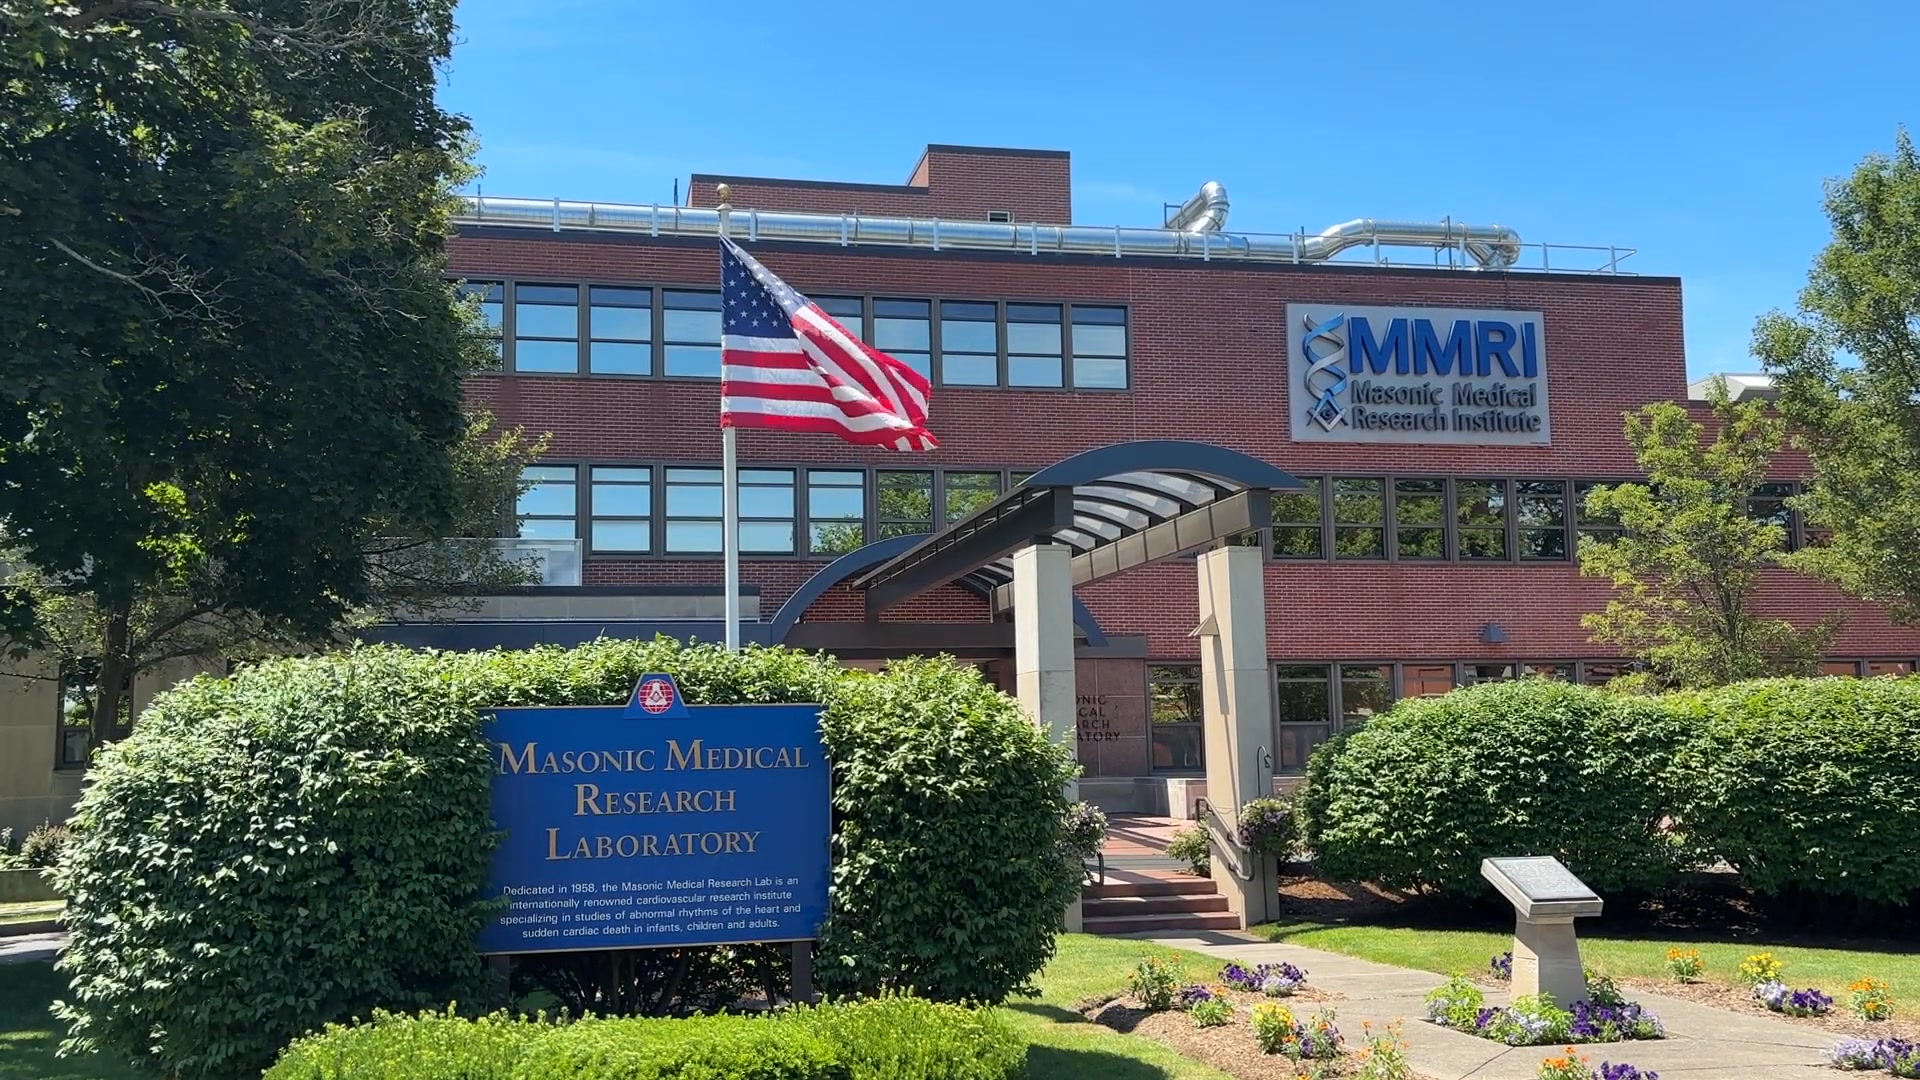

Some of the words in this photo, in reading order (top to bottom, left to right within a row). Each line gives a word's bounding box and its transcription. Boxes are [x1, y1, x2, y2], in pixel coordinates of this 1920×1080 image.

[1348, 316, 1538, 378] MMRI
[1351, 380, 1443, 406] Masonic
[1452, 382, 1537, 408] Medical
[1352, 406, 1448, 432] Research
[1452, 407, 1541, 432] Institute
[500, 742, 655, 775] MASONIC
[664, 739, 809, 772] MEDICAL
[573, 783, 736, 816] RESEARCH
[545, 828, 761, 860] LABORATORY
[503, 885, 554, 896] Dedicated
[558, 884, 567, 894] in
[571, 883, 598, 894] 1958,
[602, 882, 618, 892] the
[621, 881, 663, 892] Masonic
[666, 879, 704, 890] Medical
[708, 878, 751, 888] Research
[755, 876, 772, 887] Lab
[775, 876, 783, 886] is
[787, 877, 799, 886] an
[509, 898, 580, 910] internationally
[583, 896, 633, 907] renowned
[636, 894, 706, 906] cardiovascular
[709, 891, 750, 902] research
[753, 890, 792, 900] institute
[500, 914, 558, 926] specializing
[562, 912, 571, 923] in
[575, 911, 611, 922] studies
[615, 910, 626, 920] of
[629, 909, 675, 920] abnormal
[679, 907, 718, 919] rhythms
[722, 906, 732, 916] of
[736, 905, 751, 915] the
[755, 904, 780, 914] heart
[783, 903, 801, 913] and
[522, 927, 559, 938] sudden
[563, 926, 599, 937] cardiac
[603, 924, 631, 935] death
[634, 923, 643, 934] in
[646, 922, 683, 934] infants,
[687, 921, 724, 931] children
[727, 919, 745, 930] and
[749, 919, 780, 929] adults.
